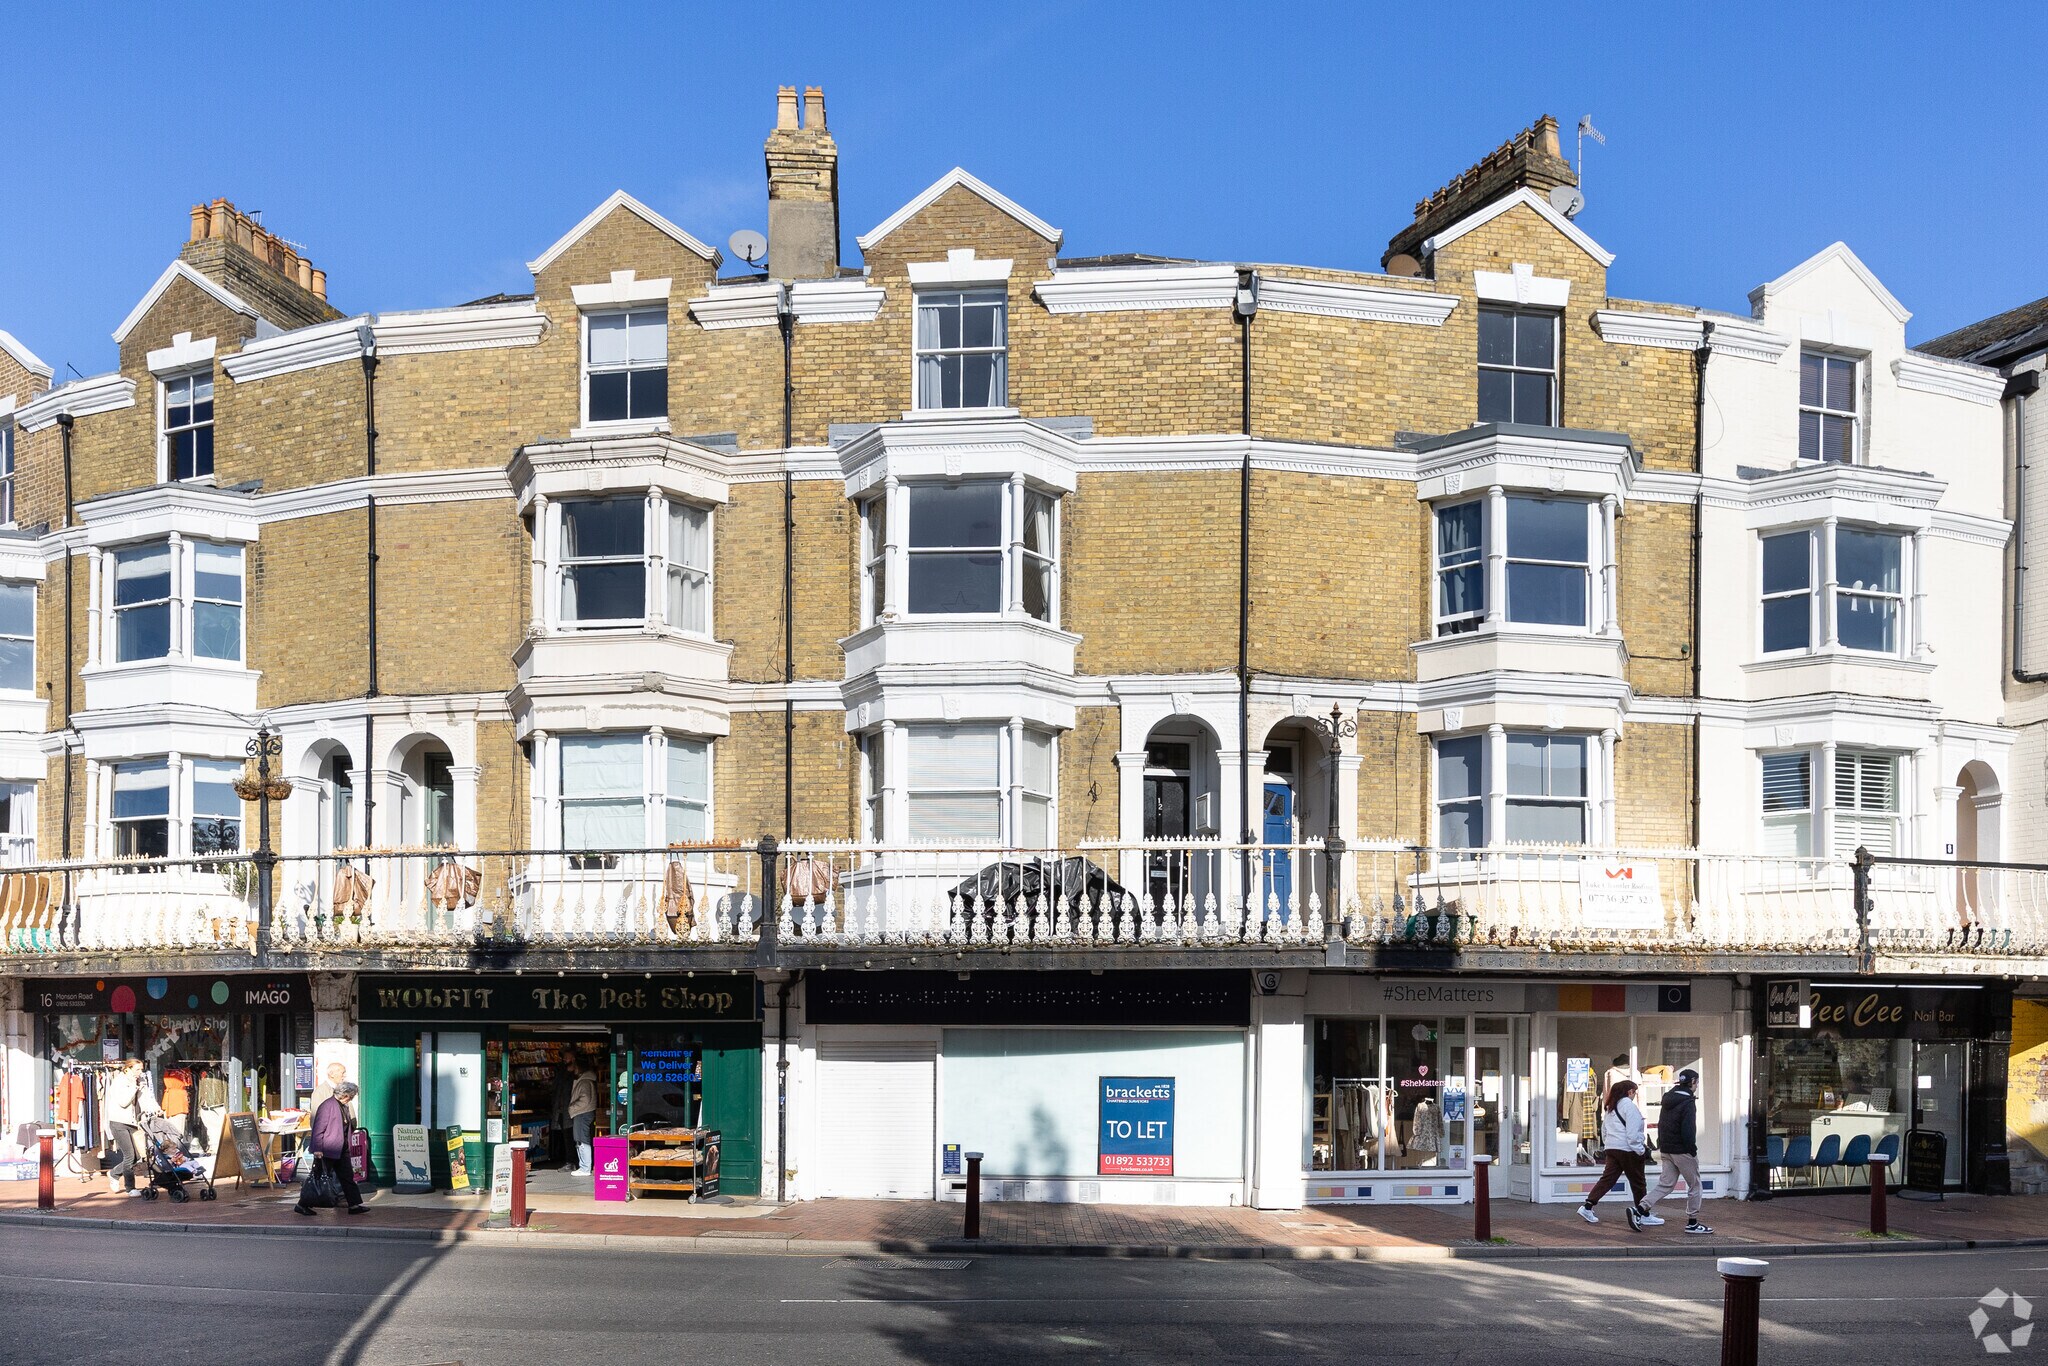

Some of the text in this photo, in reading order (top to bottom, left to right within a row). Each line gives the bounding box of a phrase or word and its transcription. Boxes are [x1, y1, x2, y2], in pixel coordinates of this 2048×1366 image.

[1947, 844, 1953, 854] 8
[40, 993, 53, 1007] 16
[78, 992, 94, 1000] Road
[245, 990, 290, 1005] IMAGO
[377, 986, 733, 1014] WOLFIT The Pet Shop
[1383, 985, 1494, 1002] #SheMatters
[1769, 985, 1784, 1006] Cee
[1769, 1011, 1798, 1023] Nail Bar
[1853, 993, 1903, 1027] Cee
[1914, 1010, 1936, 1023] Nail
[1938, 1010, 1956, 1023] Bar
[641, 1060, 694, 1070] We Deliver
[633, 1073, 663, 1082] 01892
[1400, 1079, 1446, 1087] #SheMatters
[1106, 1085, 1170, 1099] bracketts
[1106, 1120, 1168, 1139] TO LET
[1105, 1156, 1170, 1167] 01892 533733
